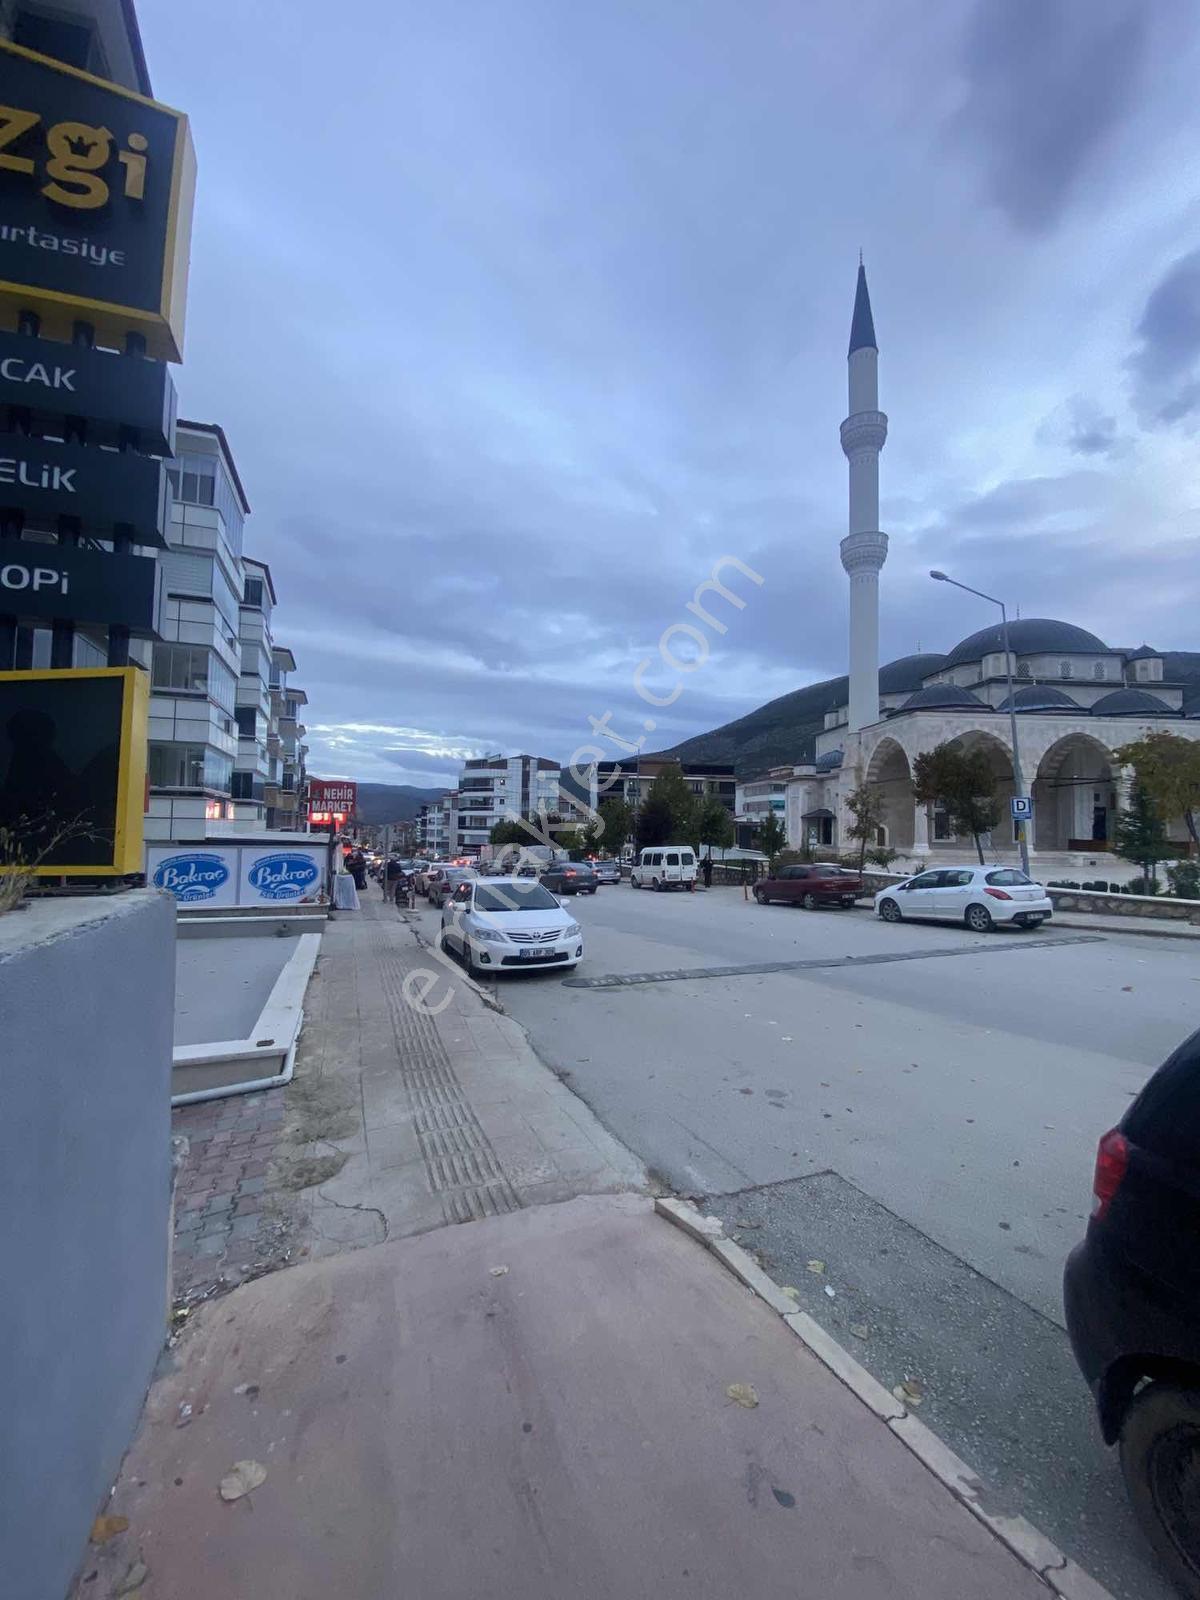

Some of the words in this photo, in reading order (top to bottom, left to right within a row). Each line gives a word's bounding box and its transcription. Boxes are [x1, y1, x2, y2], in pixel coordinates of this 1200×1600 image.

[1, 357, 77, 392] CAK
[312, 800, 353, 812] MARKET
[1016, 800, 1026, 811] D
